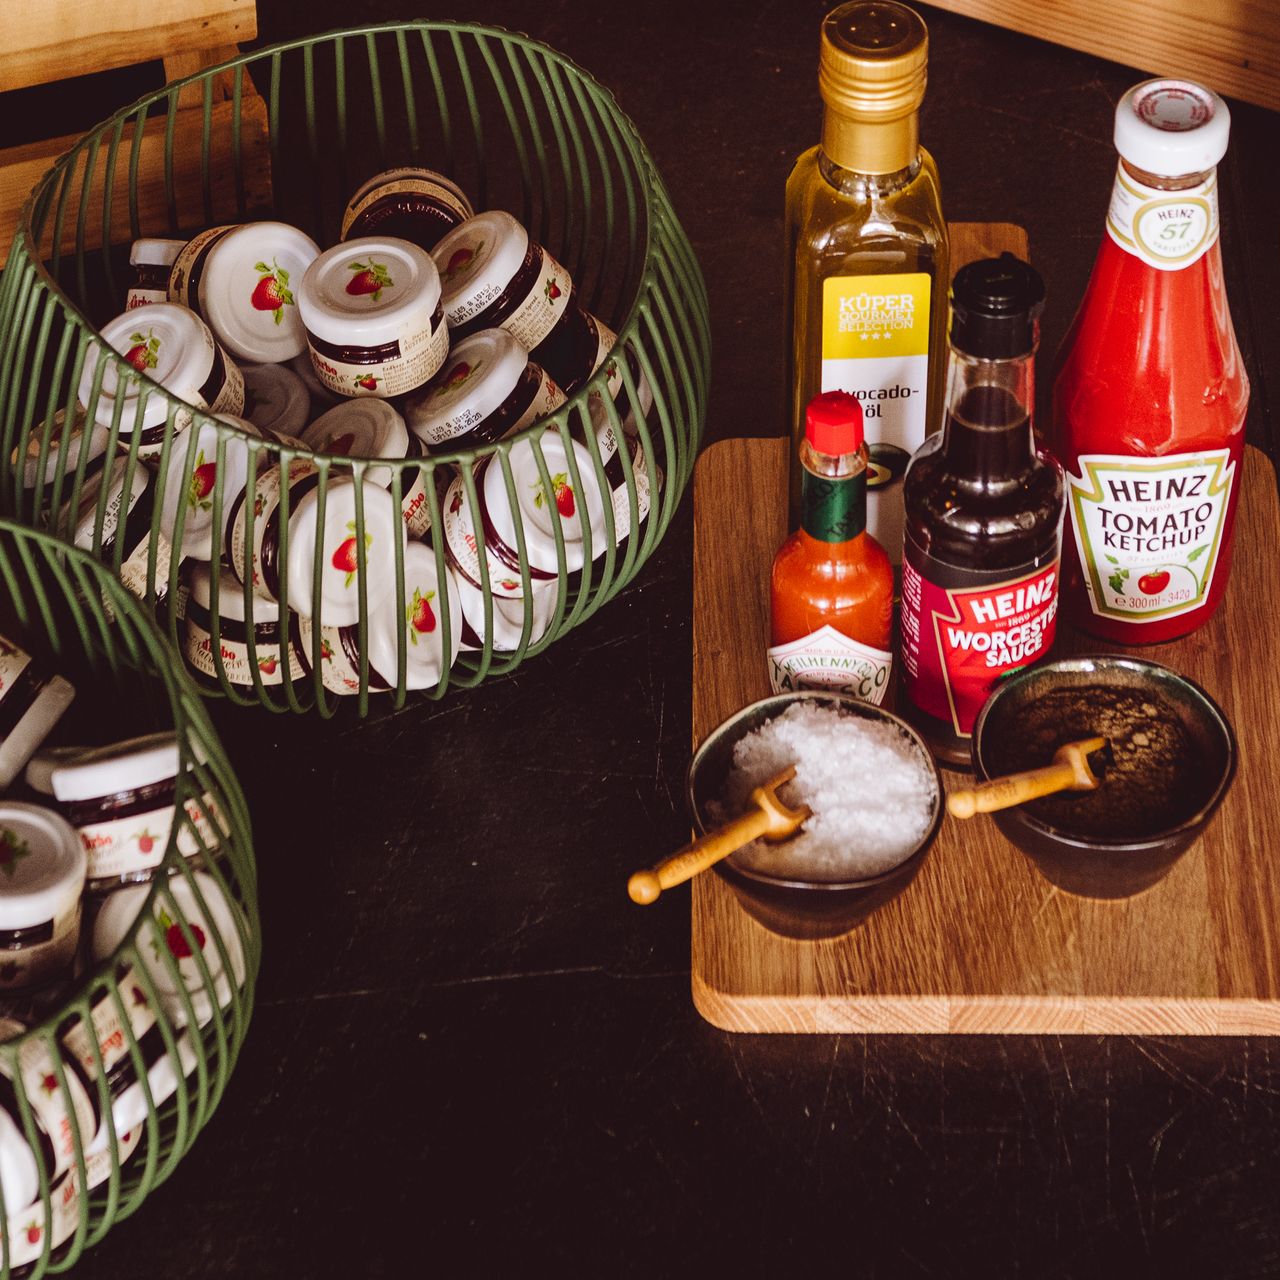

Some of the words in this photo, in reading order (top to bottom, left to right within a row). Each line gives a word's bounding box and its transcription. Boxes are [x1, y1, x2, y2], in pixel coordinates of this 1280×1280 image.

[1157, 208, 1195, 221] HEINZ
[1160, 221, 1193, 241] 57
[839, 292, 915, 313] KÜPER
[838, 308, 915, 322] GOURMET
[838, 320, 914, 333] SELECTION
[865, 403, 883, 418] öl
[1107, 474, 1208, 503] HEINZ
[1097, 502, 1213, 536] TOMATO
[1104, 524, 1206, 553] KETCHUP
[970, 571, 1056, 624] HEINZ
[985, 632, 1043, 668] SAUCE
